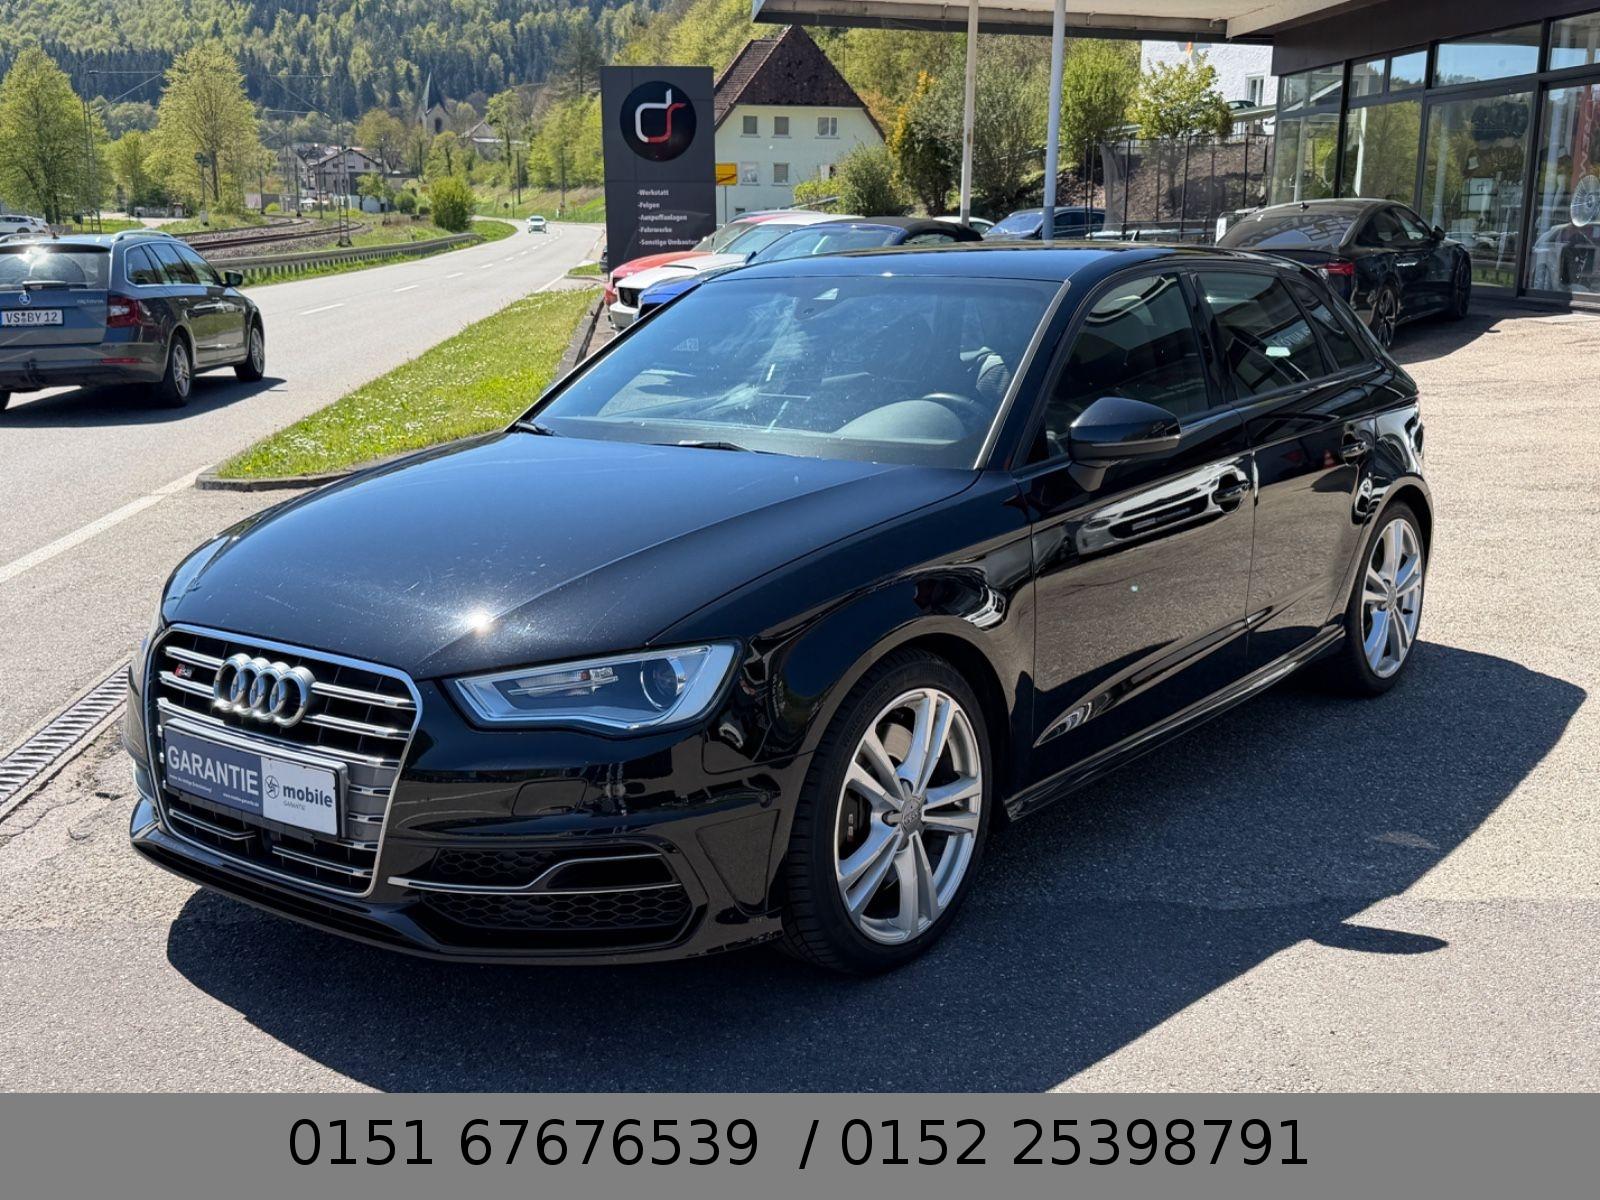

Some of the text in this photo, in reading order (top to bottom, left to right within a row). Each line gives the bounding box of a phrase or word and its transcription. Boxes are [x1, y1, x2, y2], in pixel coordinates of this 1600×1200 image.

[6, 311, 58, 323] VS BY 12
[167, 745, 259, 796] GARANTIE
[282, 785, 333, 808] mobile
